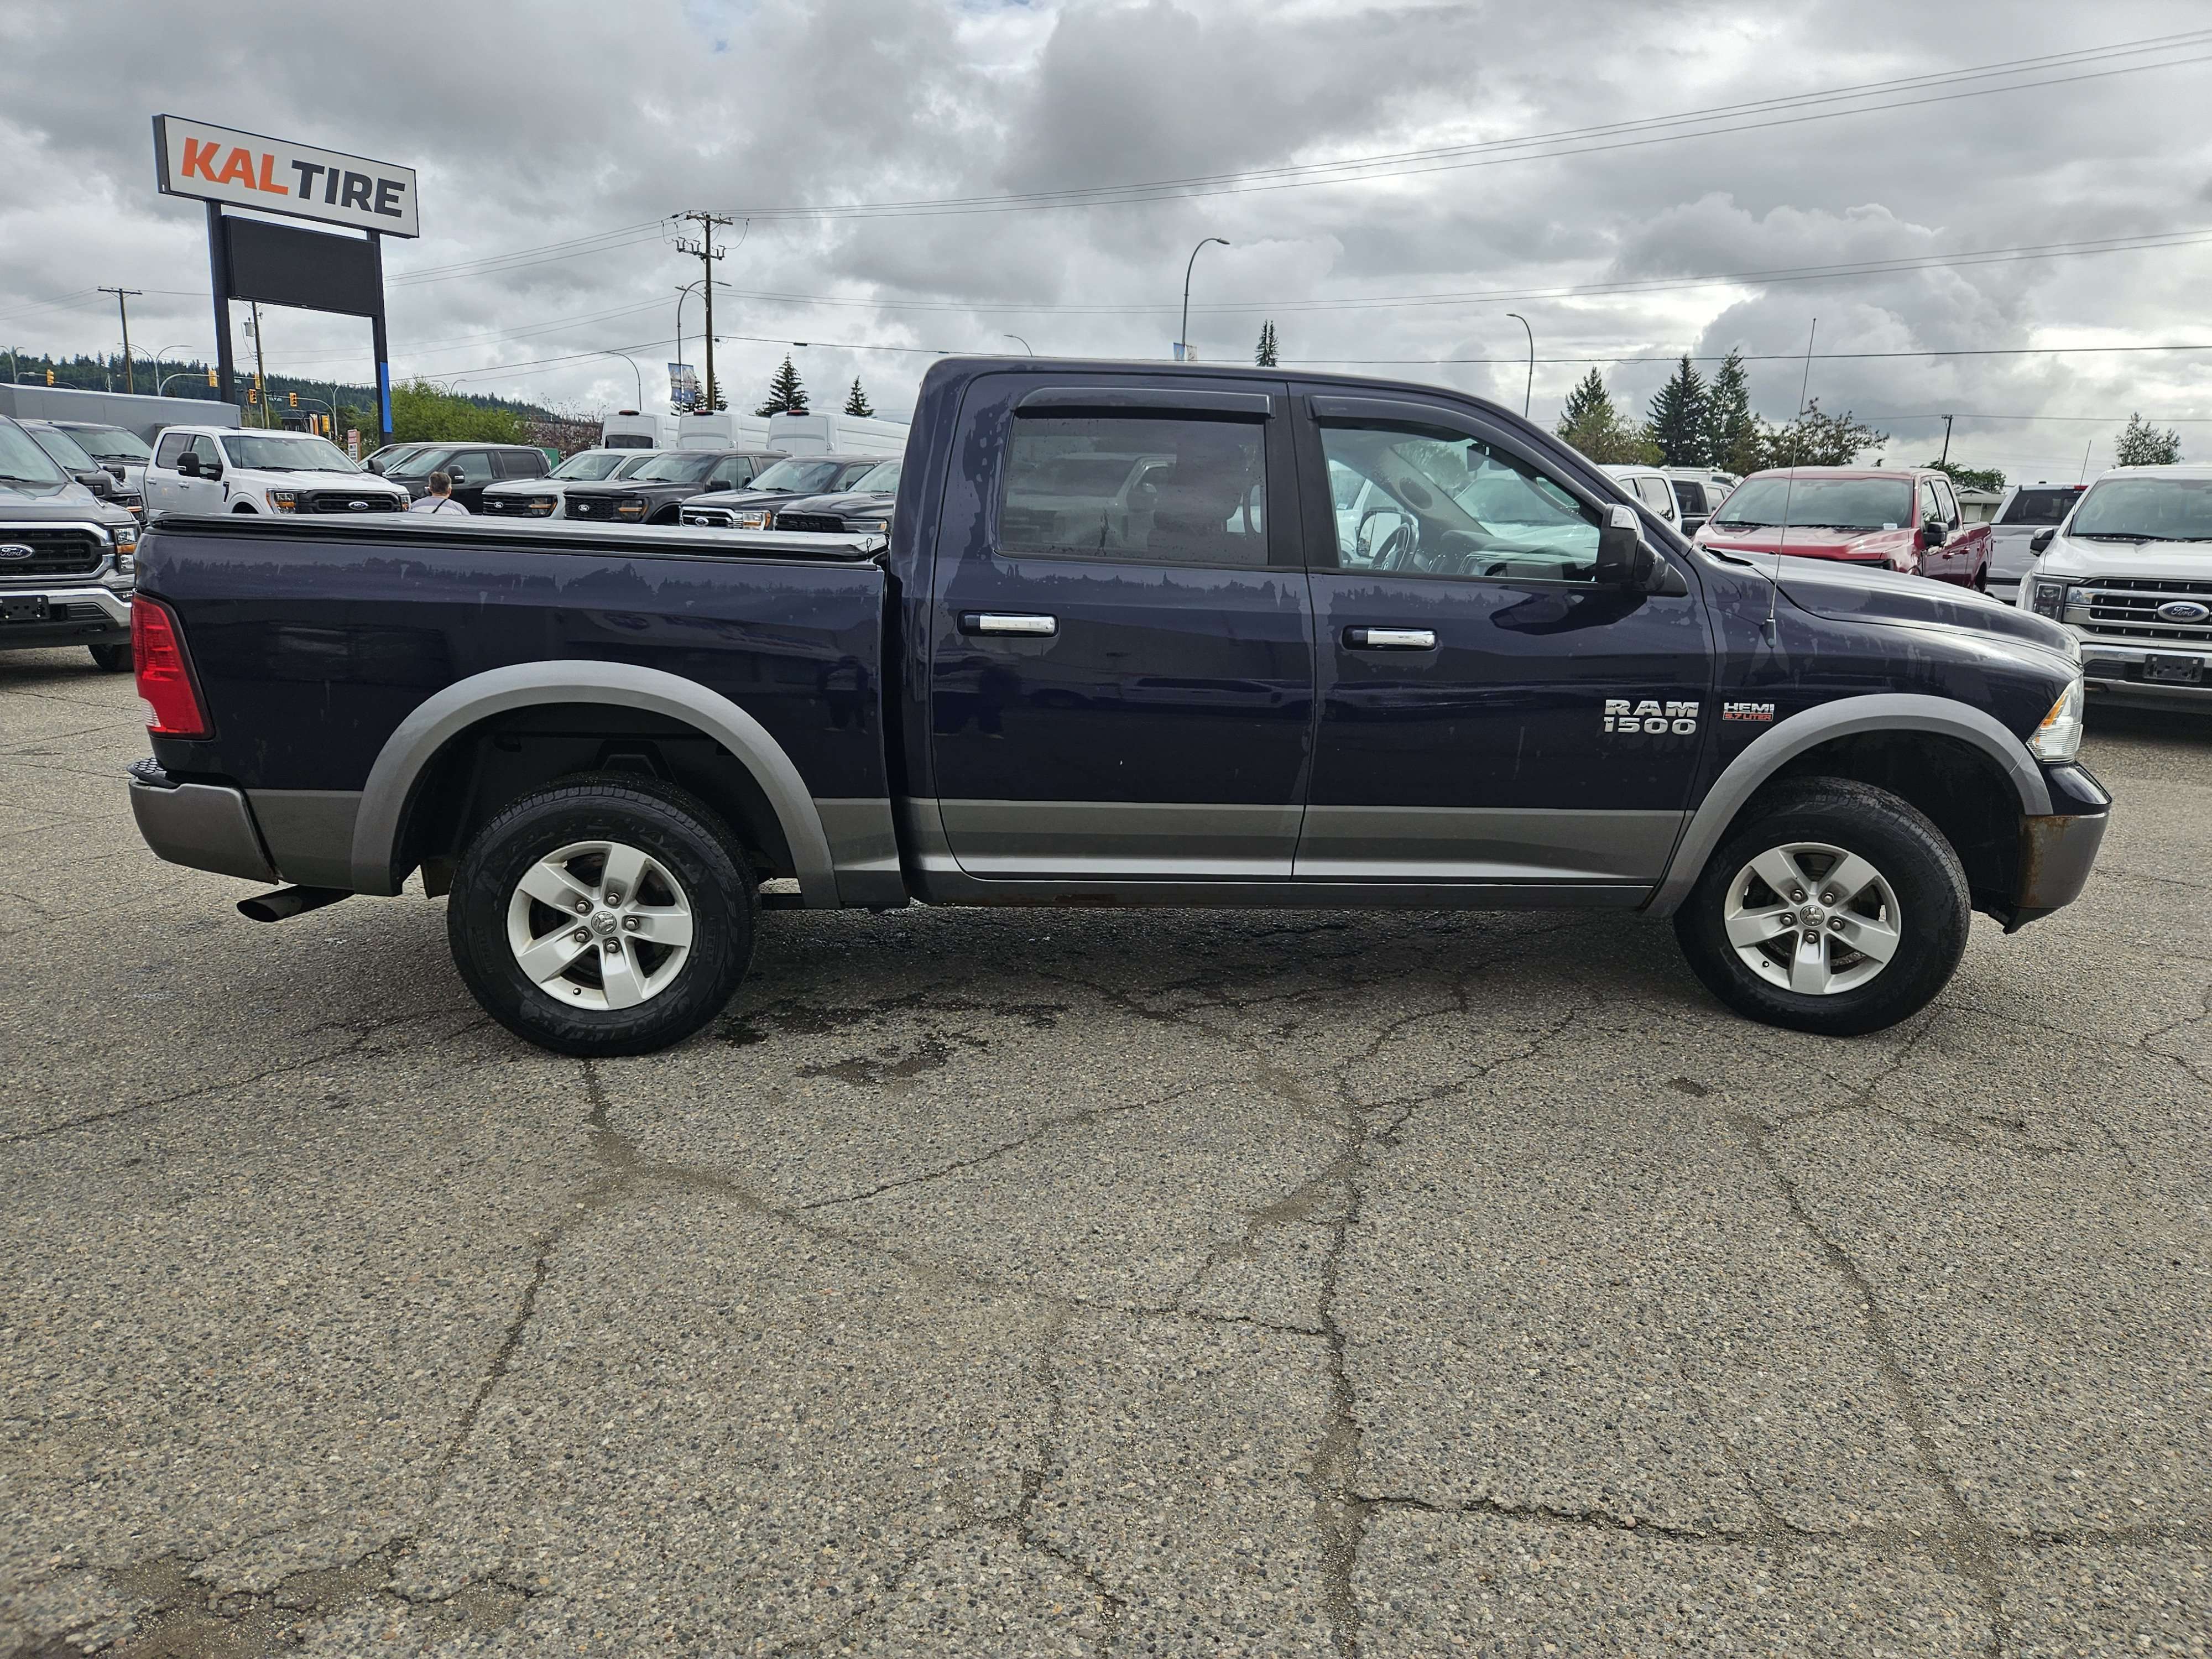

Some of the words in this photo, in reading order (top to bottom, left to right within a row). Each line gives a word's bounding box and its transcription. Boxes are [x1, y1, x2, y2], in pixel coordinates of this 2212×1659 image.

[2171, 606, 2196, 615] Ford
[1605, 699, 1699, 717] RAM
[1724, 702, 1775, 713] HEMI
[1604, 717, 1696, 734] 1500
